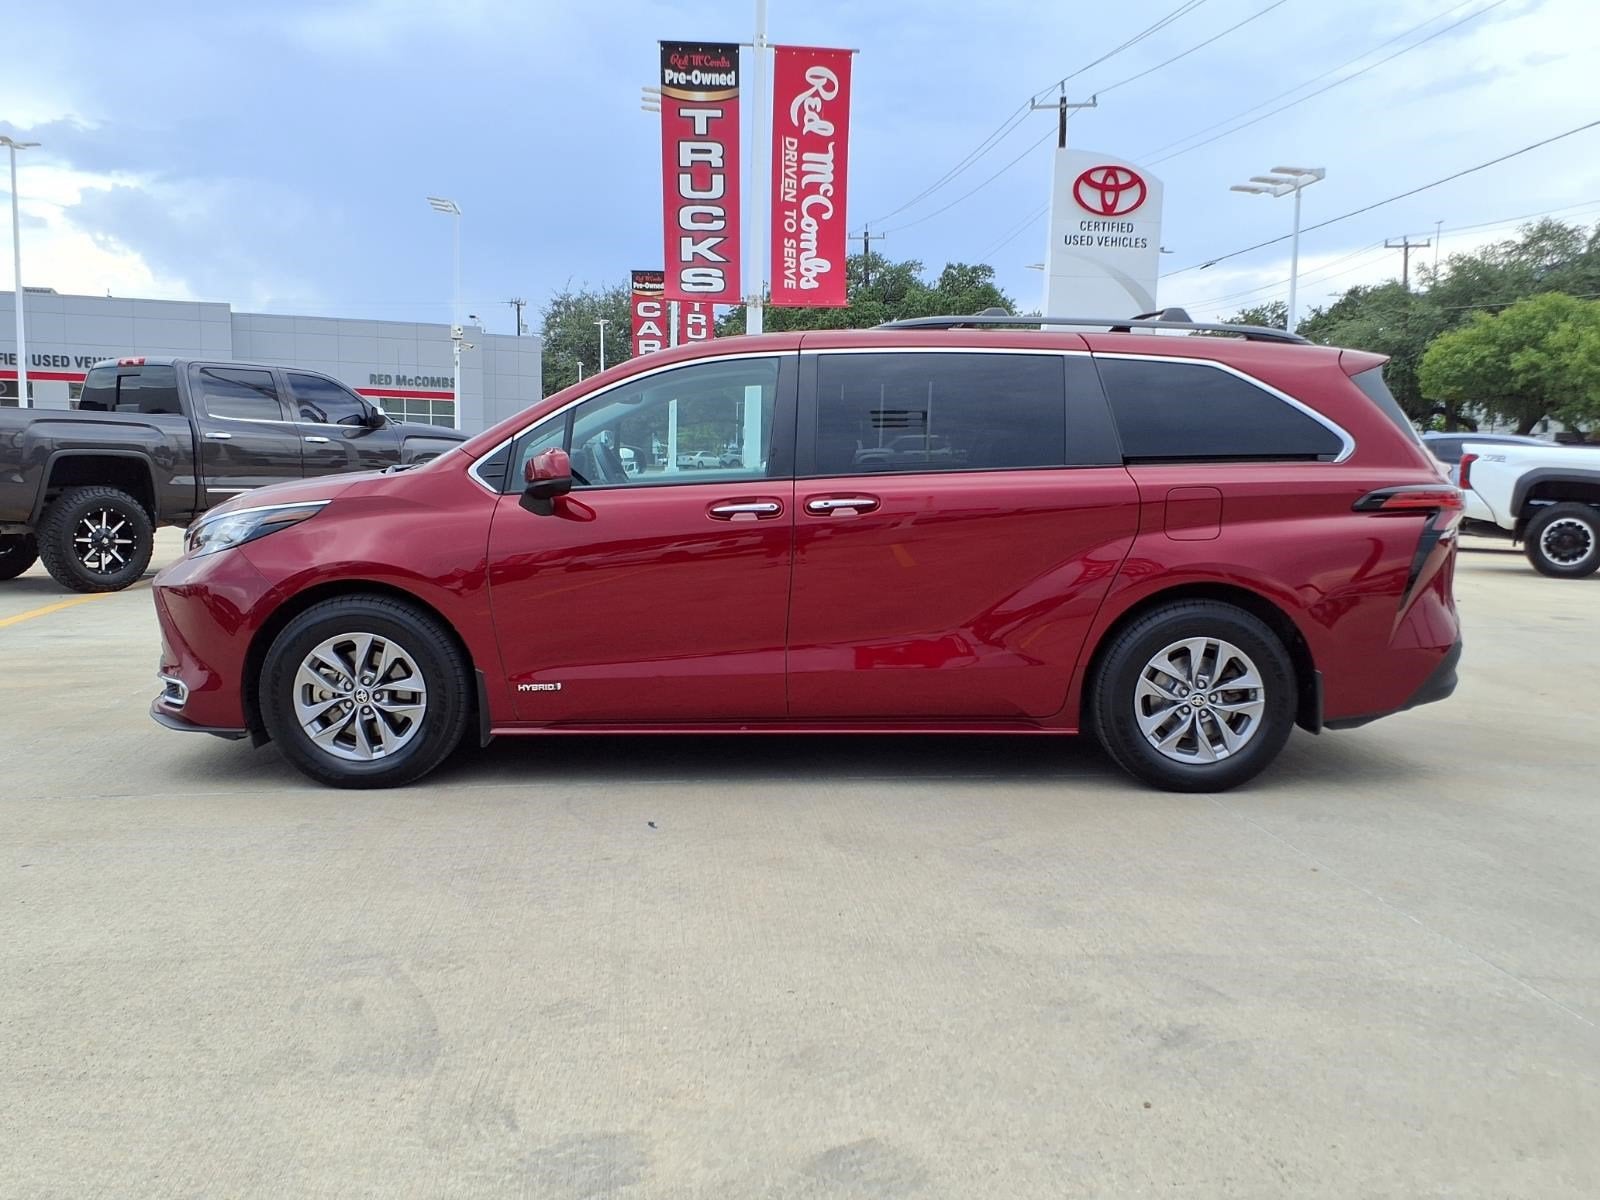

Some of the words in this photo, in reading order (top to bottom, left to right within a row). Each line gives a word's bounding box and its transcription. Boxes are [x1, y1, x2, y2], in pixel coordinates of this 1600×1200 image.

[670, 54, 689, 69] Red
[664, 69, 736, 86] Pre-Owned
[790, 66, 838, 136] Red
[785, 137, 798, 202] DRIVEN
[679, 108, 728, 293] TRUCKS
[784, 209, 797, 233] TO
[800, 141, 834, 289] McCombs
[1080, 220, 1134, 233] CERTIFIED
[1064, 234, 1094, 247] USED
[1097, 235, 1148, 249] VEHICLES
[784, 239, 797, 289] SERVE
[687, 301, 707, 342] TRU
[32, 354, 70, 368] USED
[369, 374, 392, 386] RED
[395, 375, 455, 389] McCOMBS
